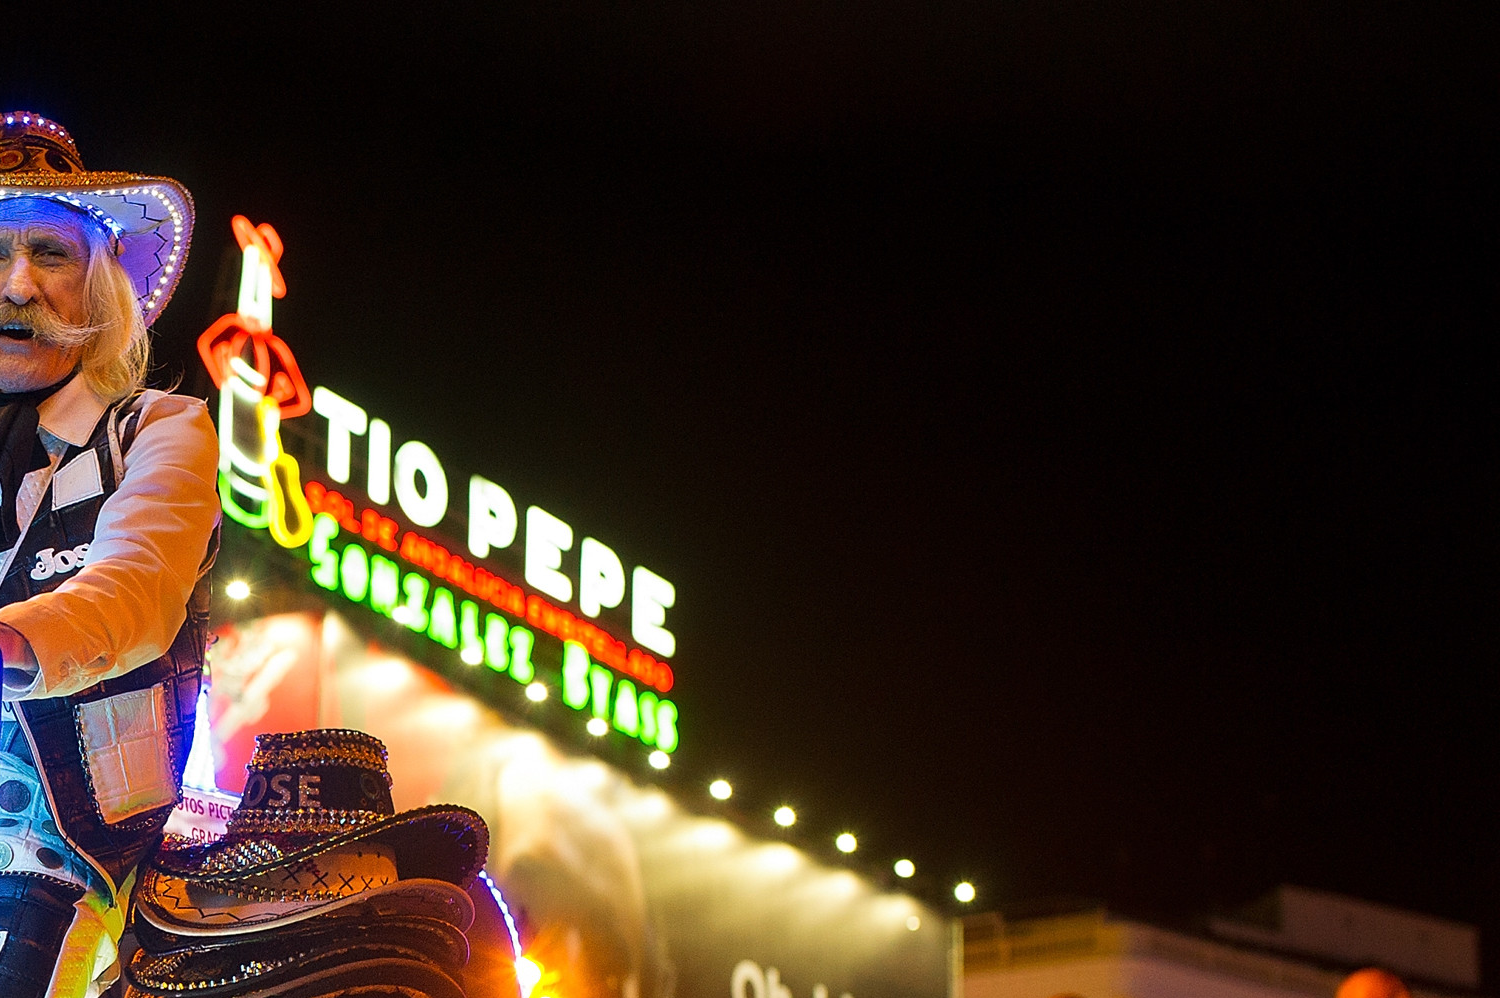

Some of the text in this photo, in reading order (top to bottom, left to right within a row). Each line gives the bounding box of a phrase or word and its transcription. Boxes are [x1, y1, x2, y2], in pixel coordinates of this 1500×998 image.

[313, 386, 676, 659] TIO PEPE
[562, 638, 679, 753] BYASS
[208, 802, 234, 820] PICT
